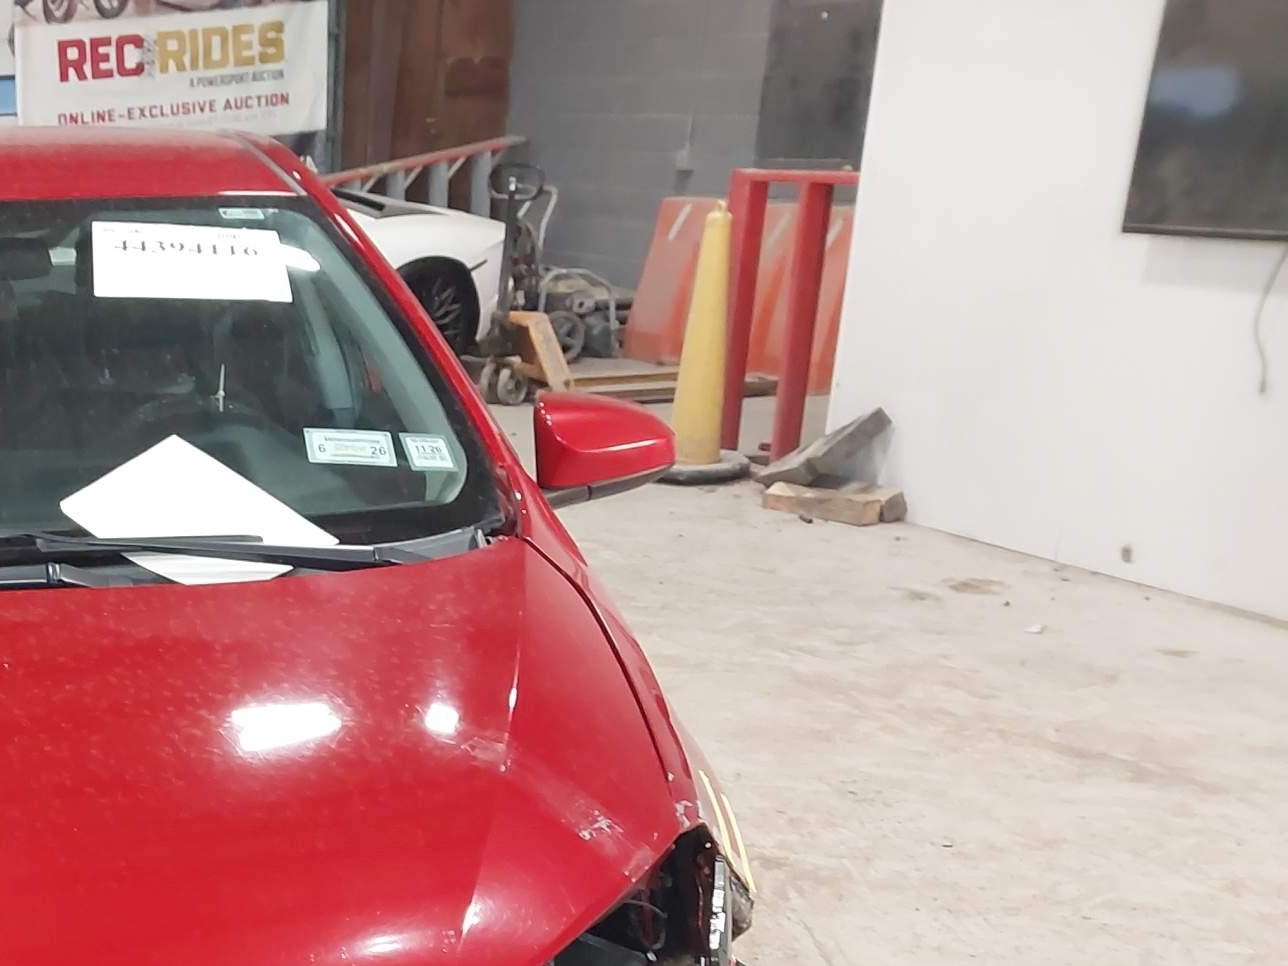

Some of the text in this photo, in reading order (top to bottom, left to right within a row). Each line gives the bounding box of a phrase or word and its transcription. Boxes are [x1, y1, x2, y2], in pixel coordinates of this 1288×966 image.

[57, 20, 285, 82] REC RIDES
[57, 92, 290, 127] ONLINE-EXCLUSIVE AUCTION
[318, 443, 387, 456] 6 26
